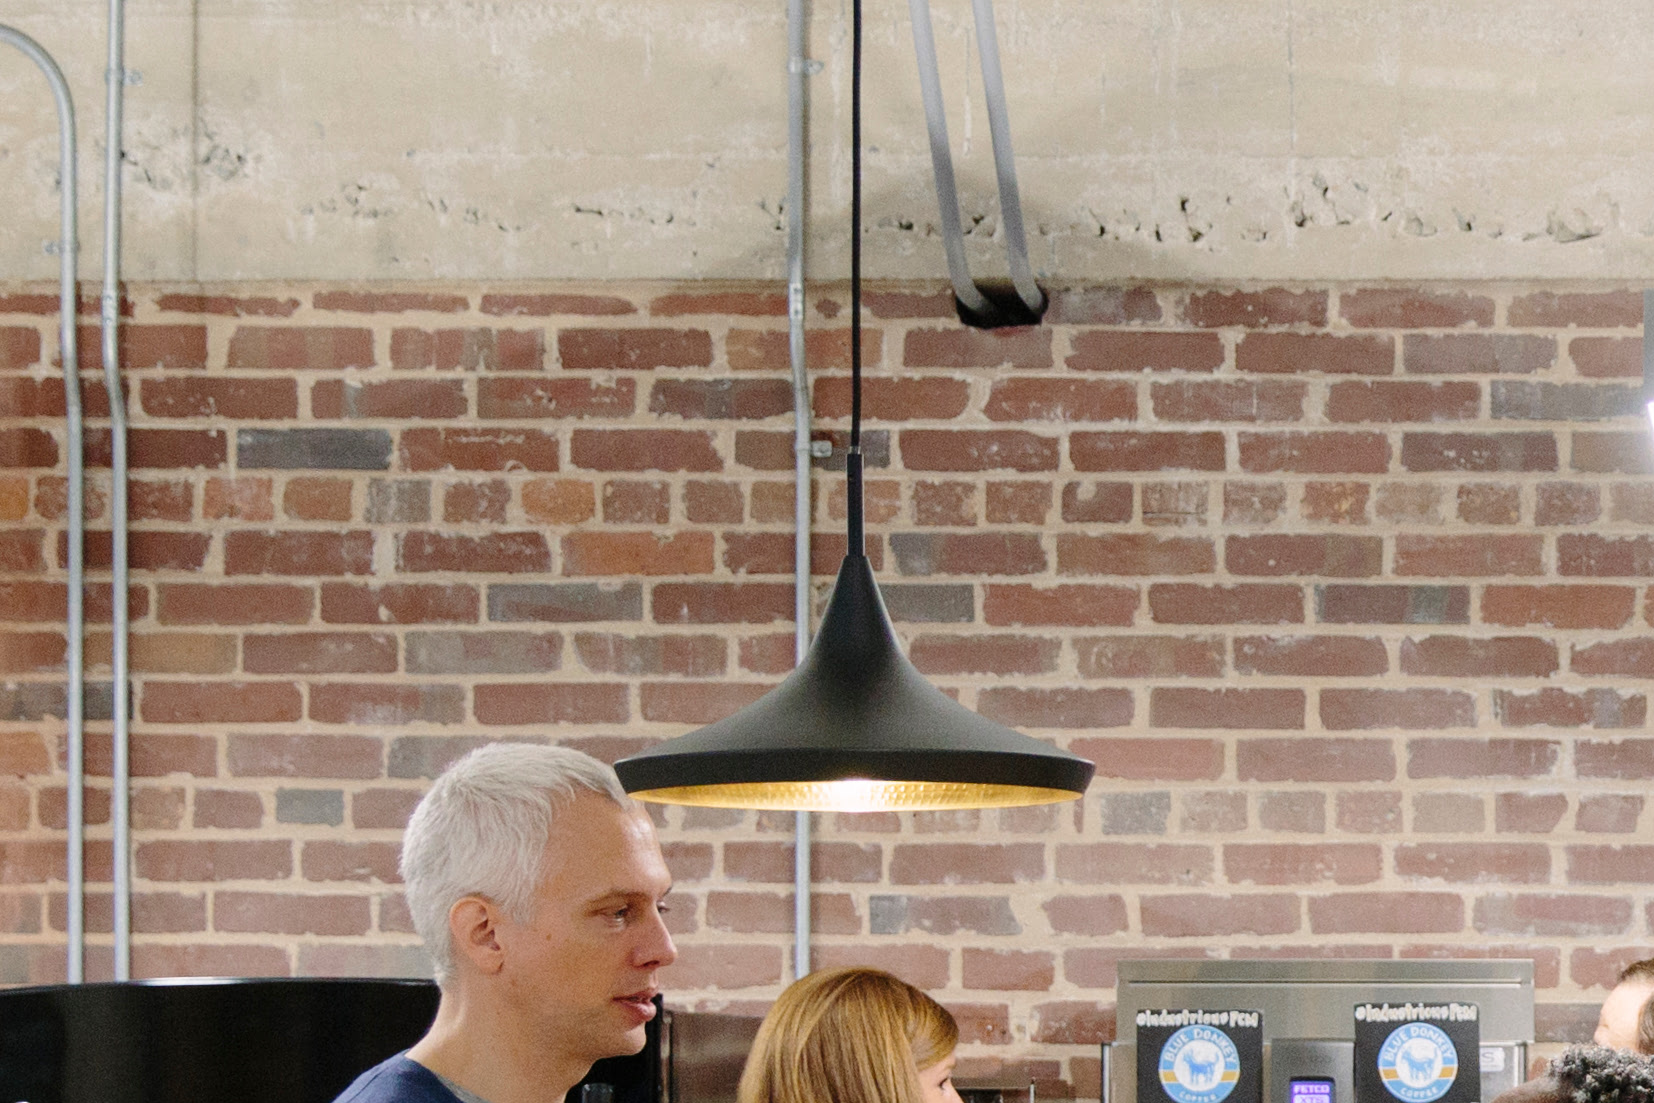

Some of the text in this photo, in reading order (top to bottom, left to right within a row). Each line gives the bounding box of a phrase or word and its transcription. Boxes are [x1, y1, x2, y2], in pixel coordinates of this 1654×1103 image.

[1165, 1029, 1236, 1063] BLUE DONKEY
[1383, 1026, 1454, 1060] BLUE DONKEY
[1293, 1084, 1330, 1094] FETCO
[1401, 1086, 1438, 1098] COFFEE
